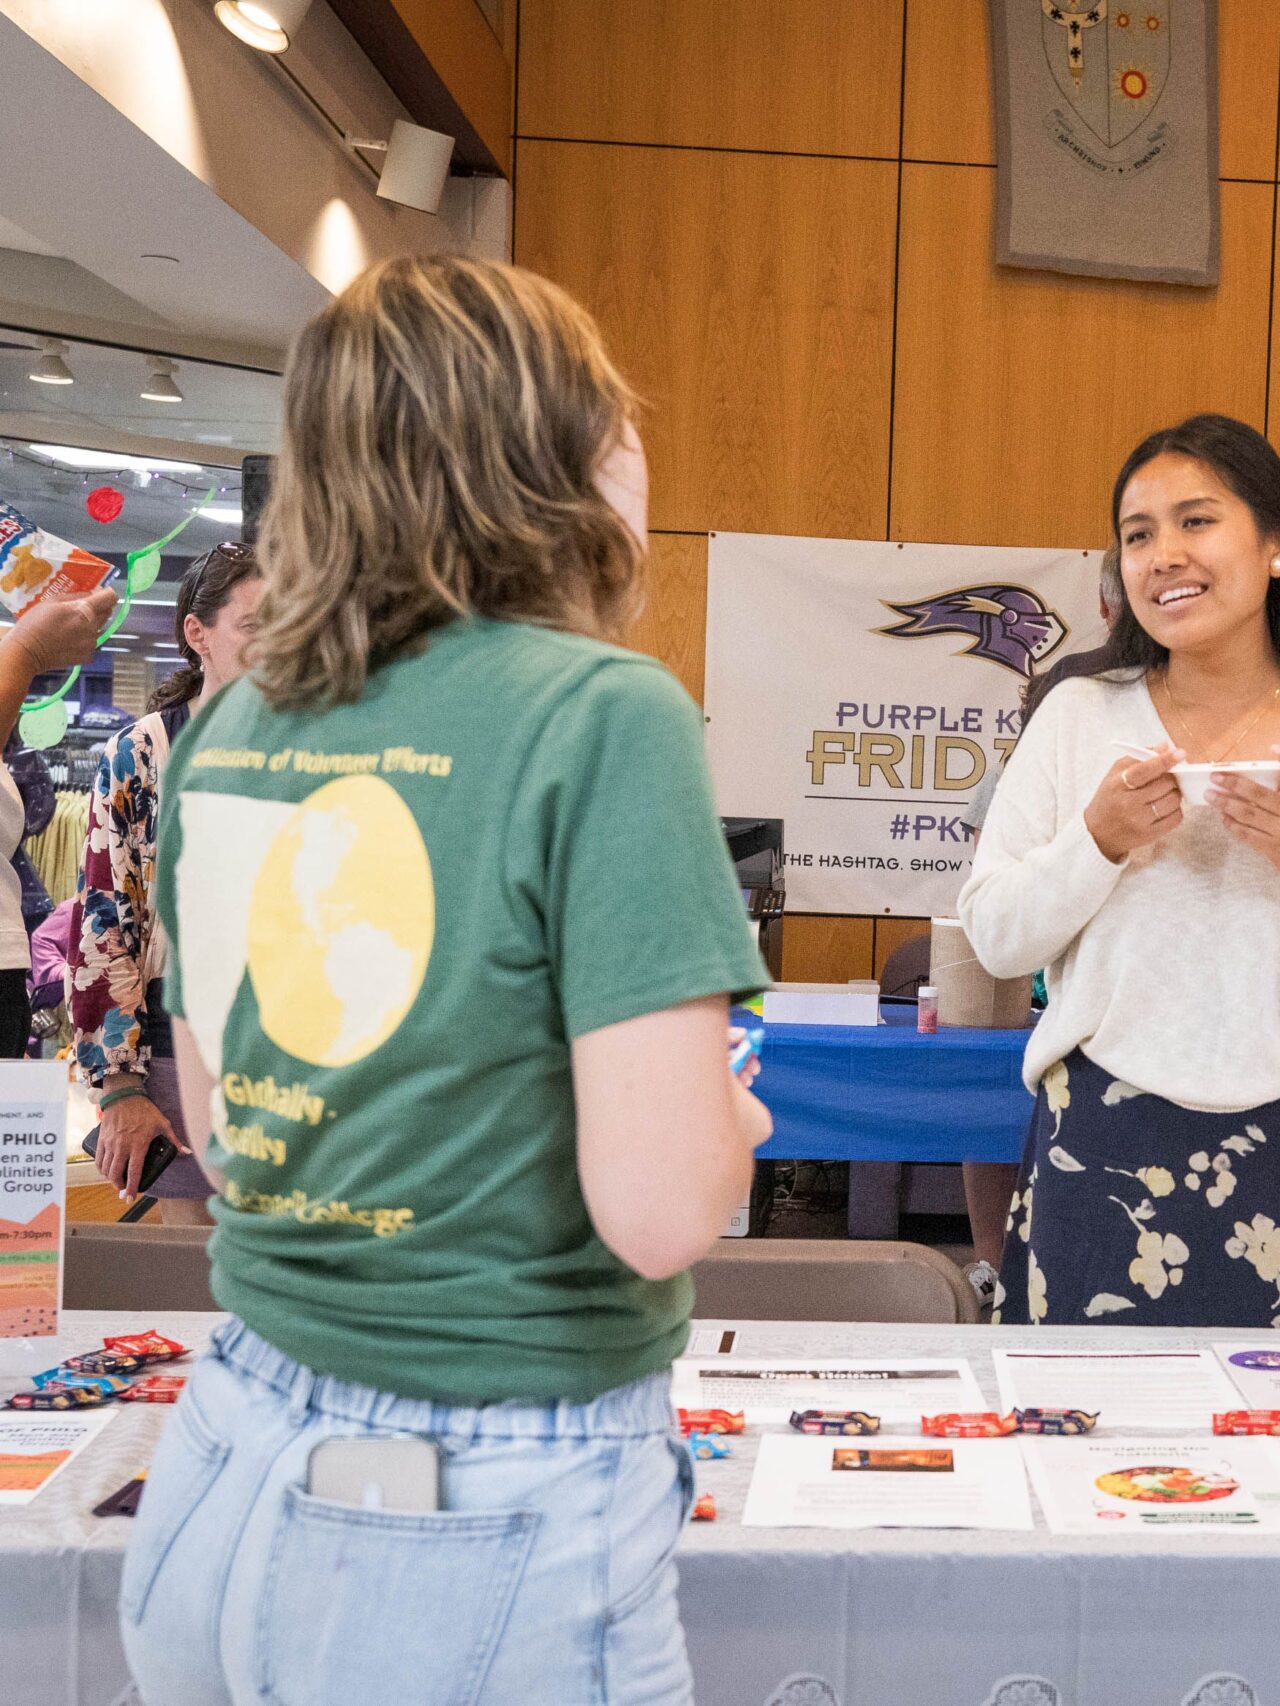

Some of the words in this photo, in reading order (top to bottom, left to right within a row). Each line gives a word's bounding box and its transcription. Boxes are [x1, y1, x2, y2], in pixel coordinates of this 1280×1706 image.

[836, 702, 983, 733] PURPLE
[819, 855, 904, 871] HASHTAG.
[910, 859, 963, 872] SHOW
[3, 1132, 57, 1146] PHILO
[25, 1151, 54, 1163] and
[4, 1180, 53, 1195] Group
